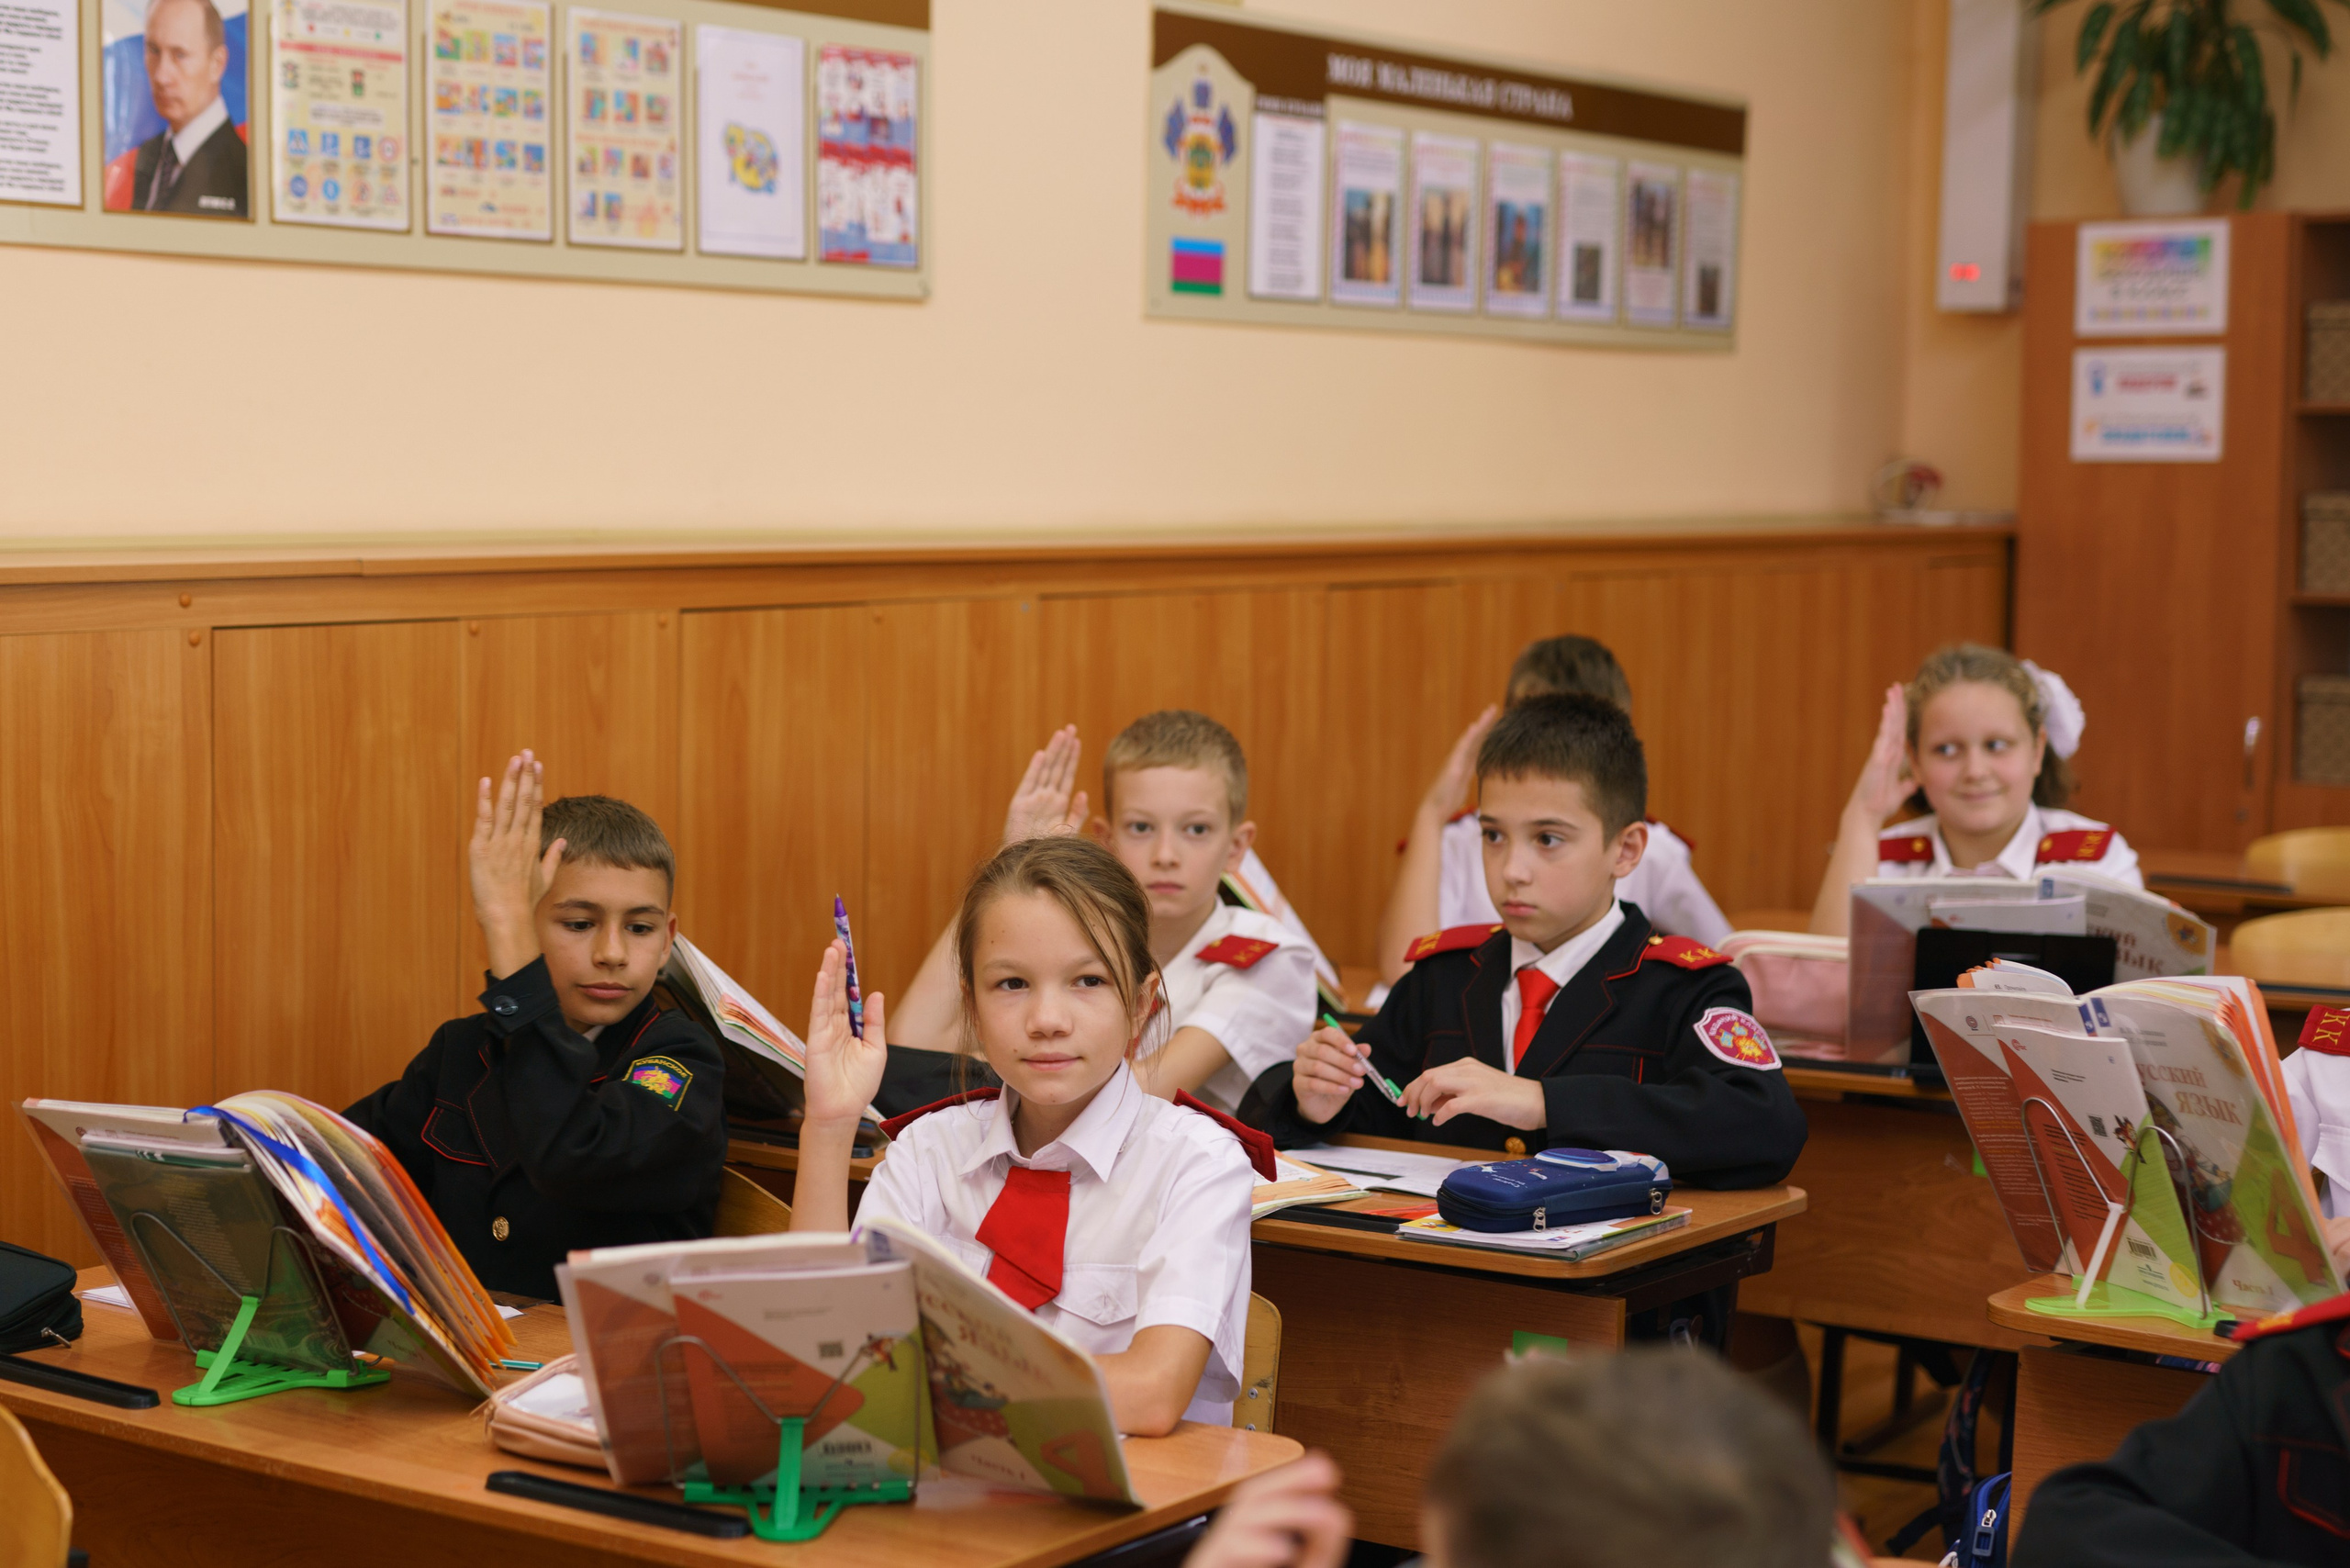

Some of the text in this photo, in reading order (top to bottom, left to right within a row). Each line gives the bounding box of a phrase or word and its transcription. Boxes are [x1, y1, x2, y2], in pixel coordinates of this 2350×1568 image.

[1326, 52, 1373, 89] МОЯ
[1376, 61, 1497, 109] МАЛЕНЬКАЯ
[1498, 80, 1574, 123] СТРАНА
[2312, 1012, 2350, 1045] КК
[2135, 1062, 2208, 1088] УССКИЙ
[2175, 1091, 2244, 1126] ЯЗЫК
